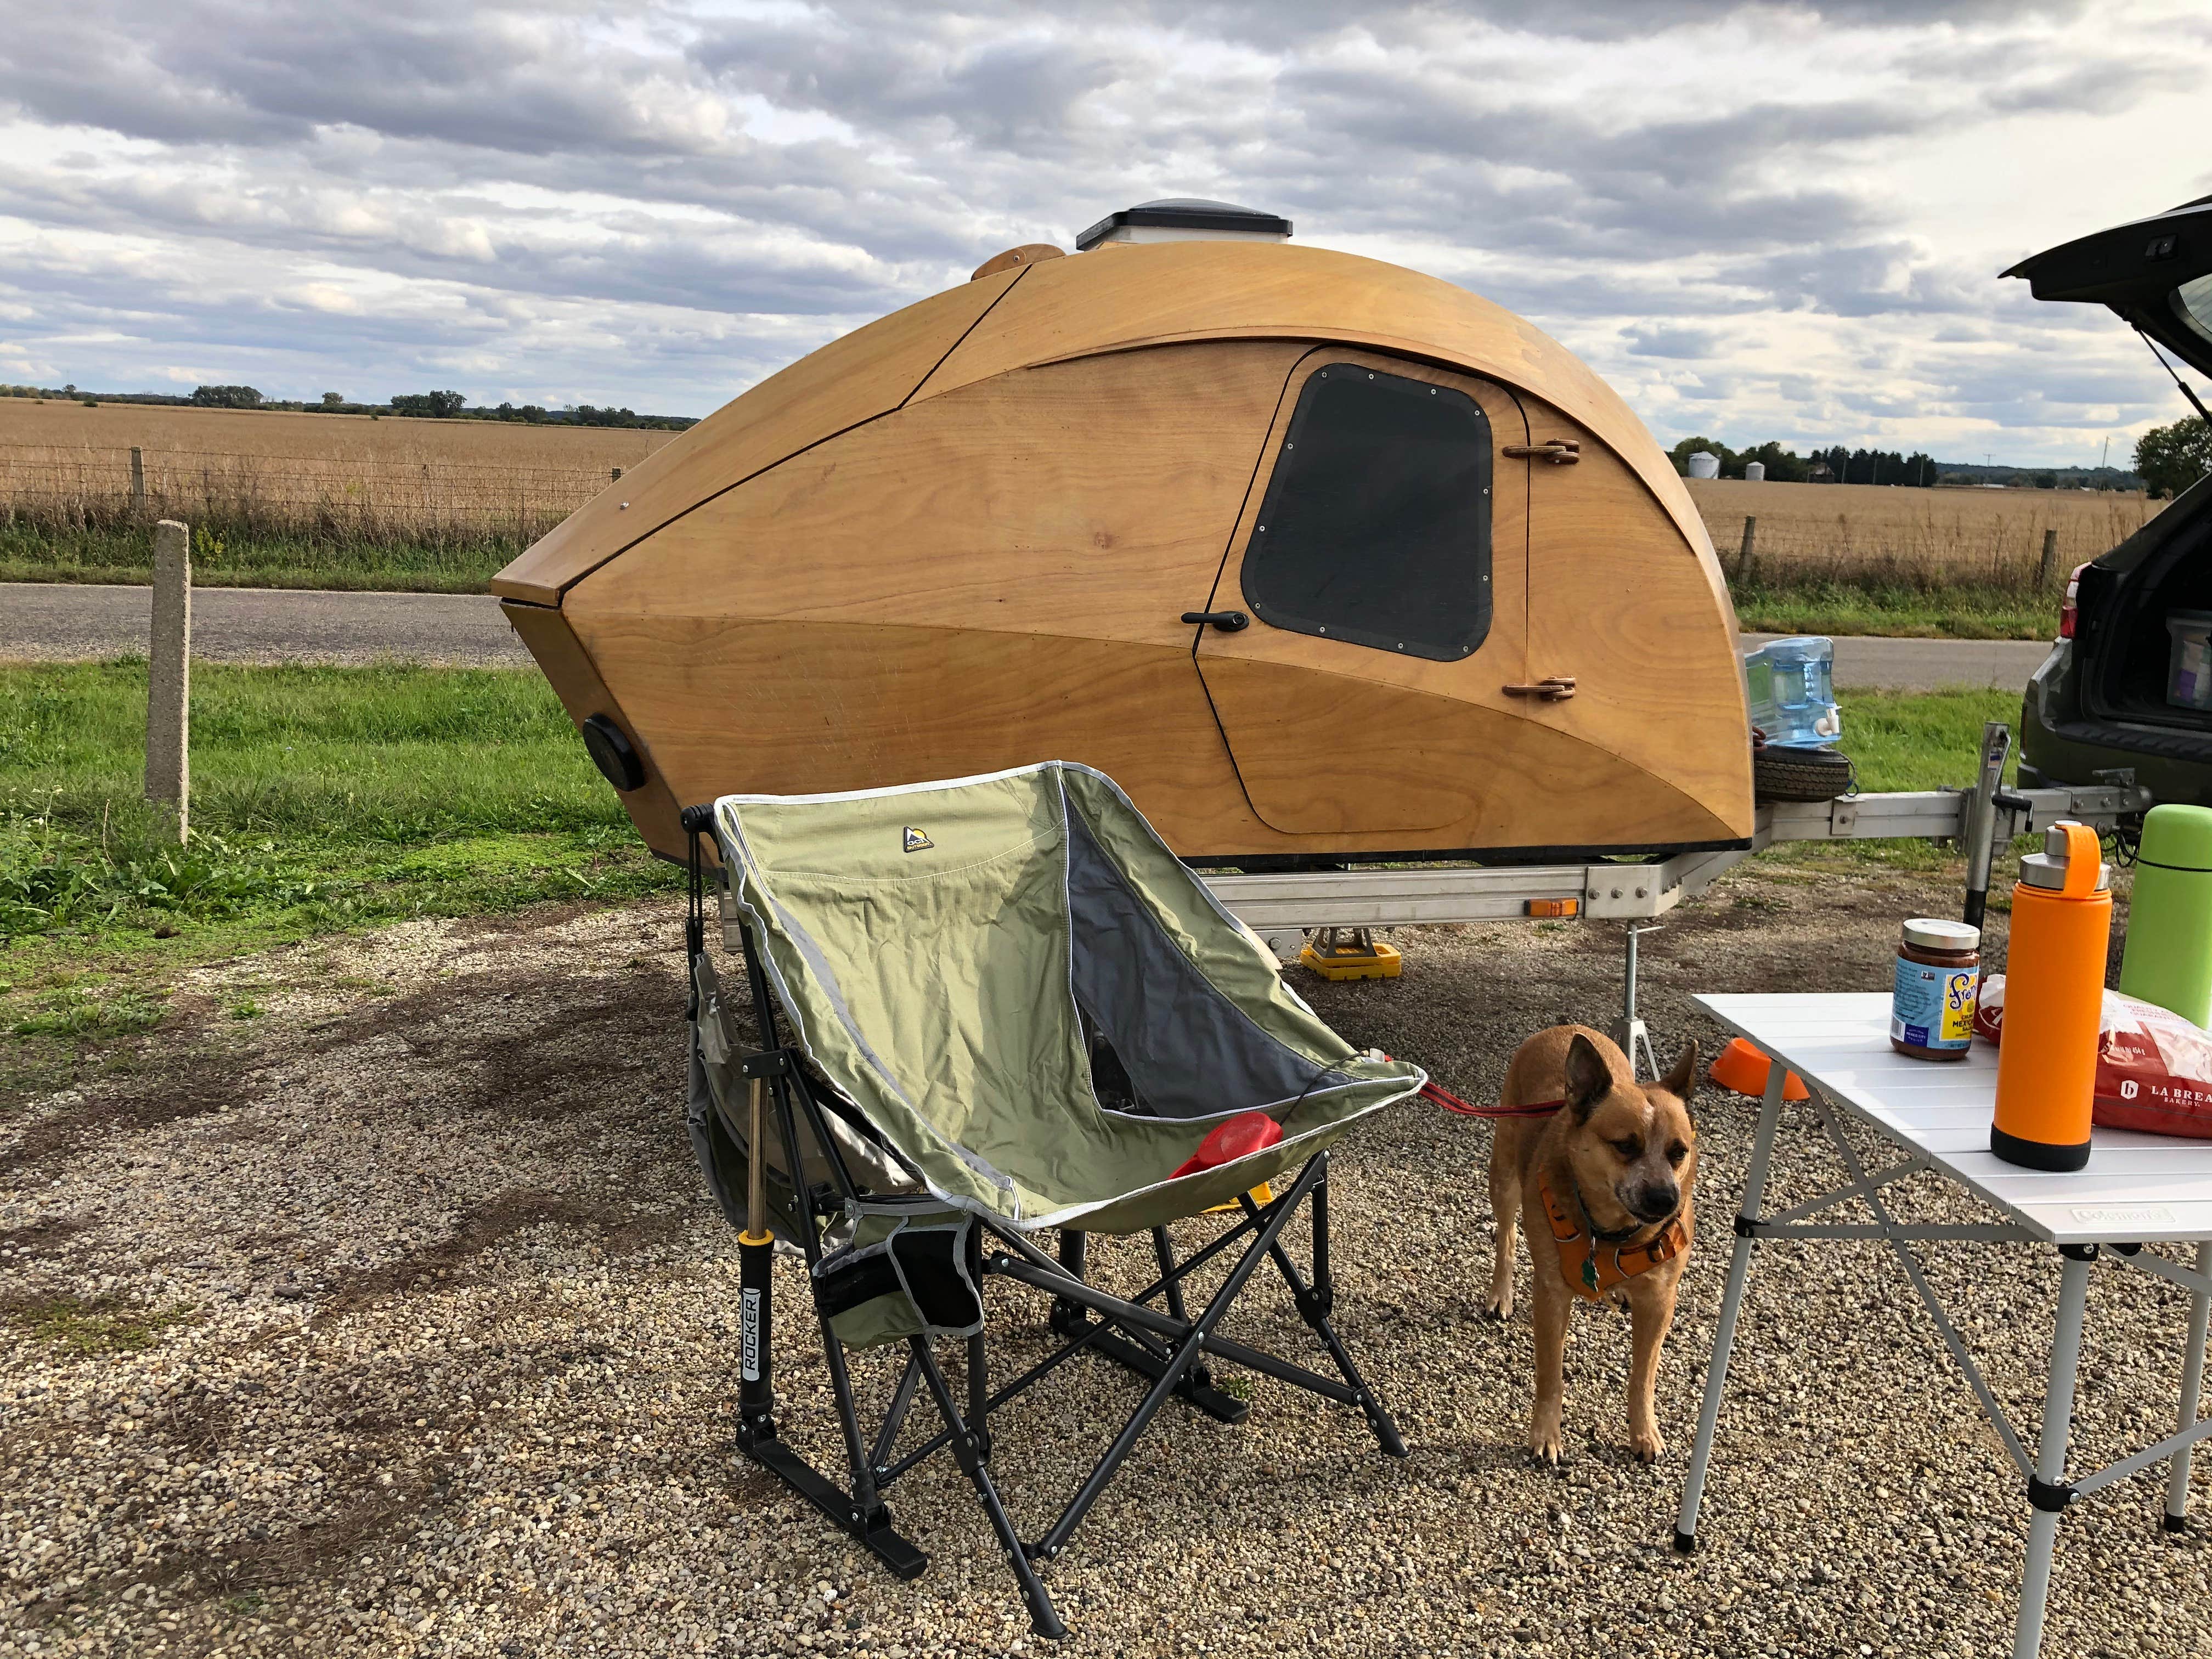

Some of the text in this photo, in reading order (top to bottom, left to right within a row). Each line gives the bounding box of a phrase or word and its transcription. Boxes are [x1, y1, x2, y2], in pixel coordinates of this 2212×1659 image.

[2151, 1085, 2212, 1103] LA BREA
[745, 1298, 757, 1371] ROCKER
